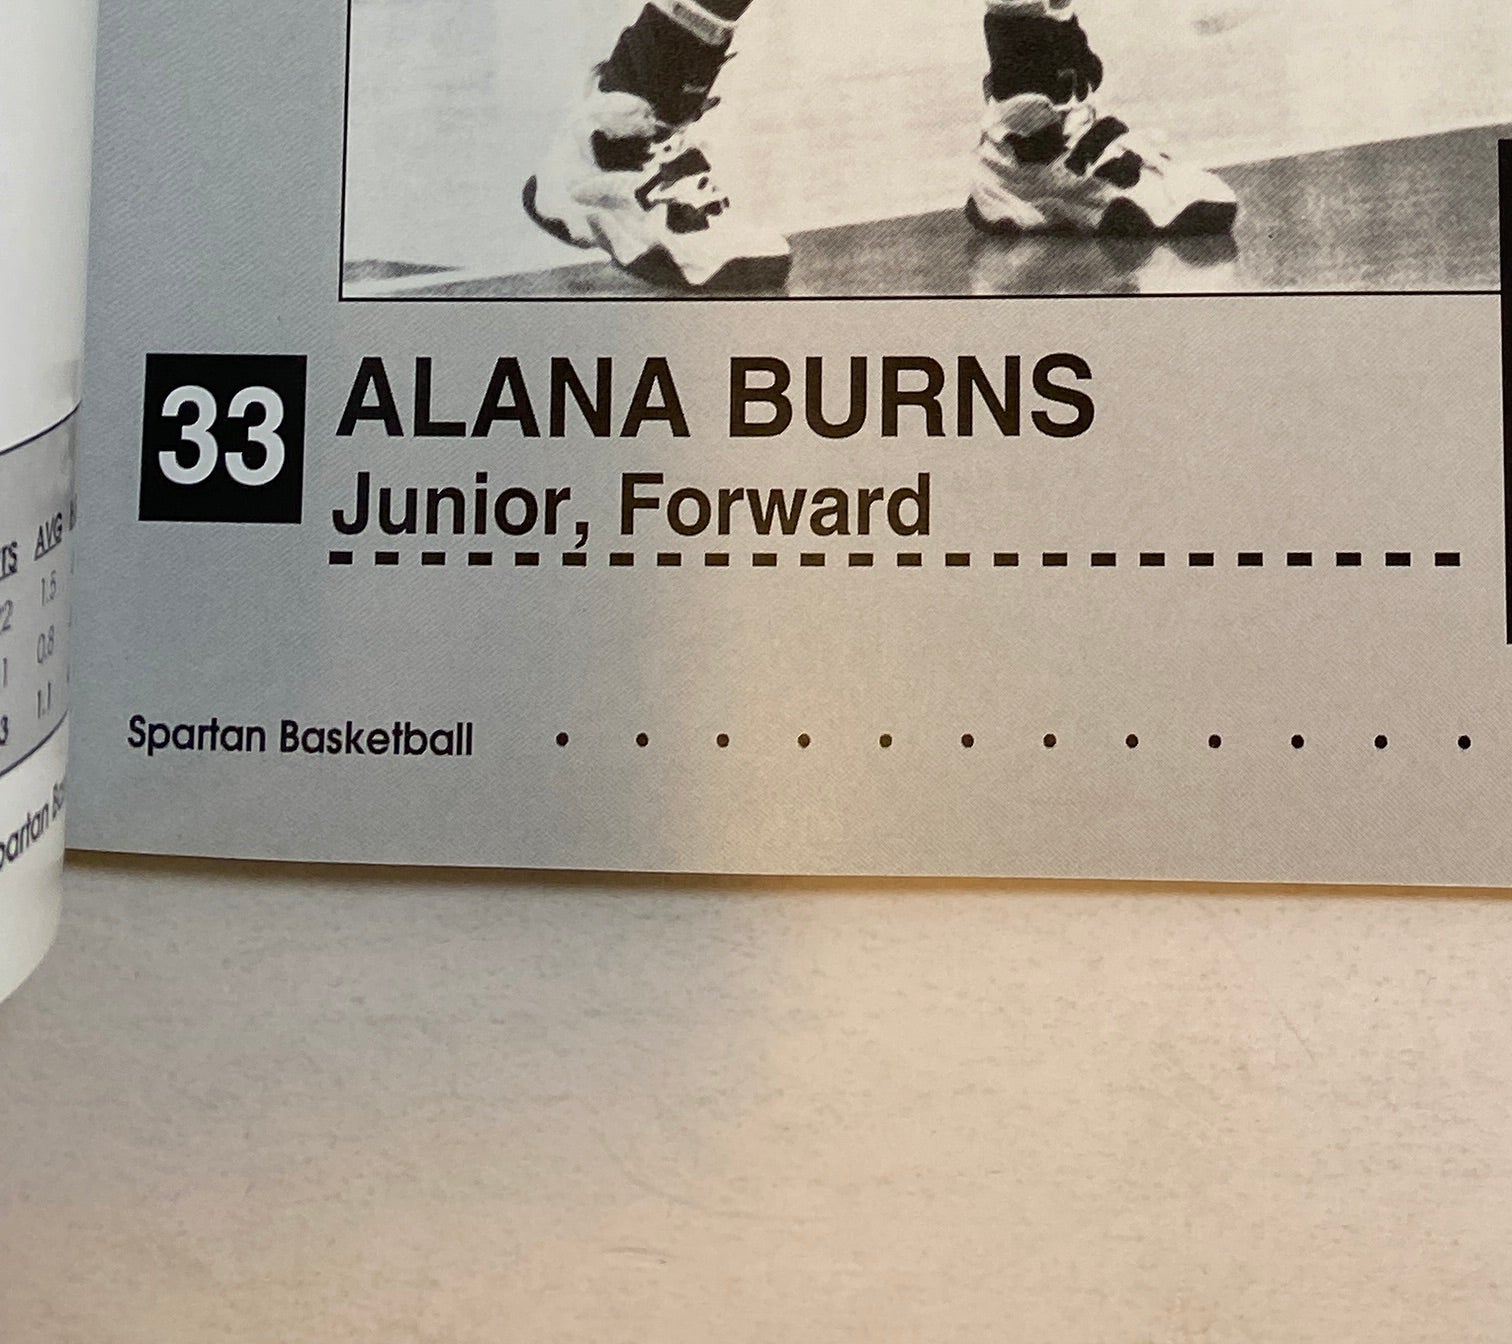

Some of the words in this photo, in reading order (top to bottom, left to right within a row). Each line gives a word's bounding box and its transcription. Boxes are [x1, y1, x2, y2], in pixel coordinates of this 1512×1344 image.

[157, 385, 286, 486] 33
[335, 356, 691, 438] ALANA
[729, 352, 1095, 439] BURNS
[332, 471, 590, 550] Junior,
[620, 472, 930, 537] Forward
[127, 714, 266, 757] Spartan
[279, 718, 473, 758] Basketball
